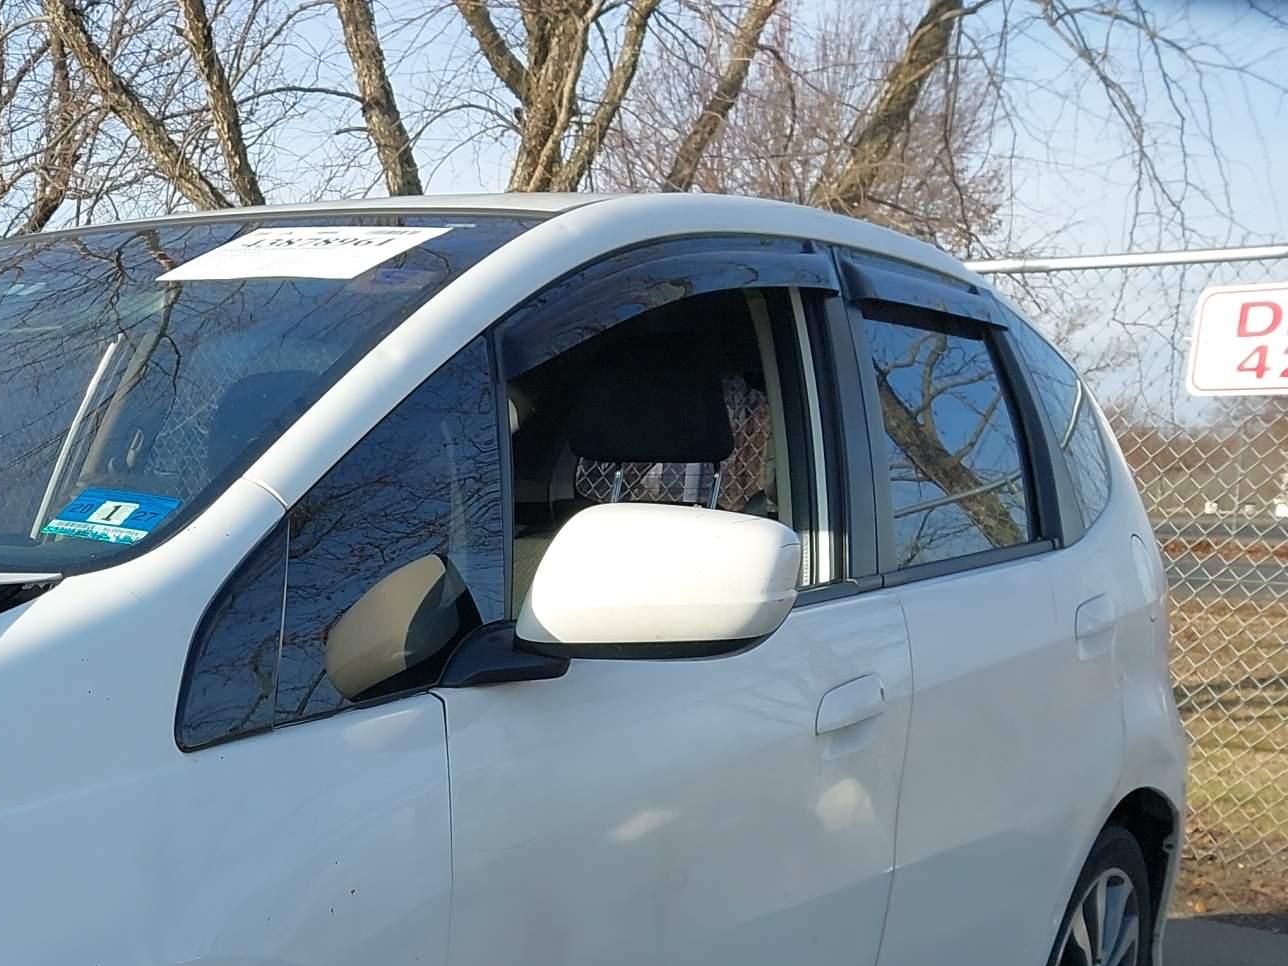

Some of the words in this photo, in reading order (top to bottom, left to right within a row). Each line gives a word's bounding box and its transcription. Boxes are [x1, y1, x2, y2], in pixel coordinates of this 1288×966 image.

[1236, 301, 1288, 337] D
[67, 503, 95, 514] 20
[102, 504, 123, 522] 1
[133, 510, 161, 521] 27
